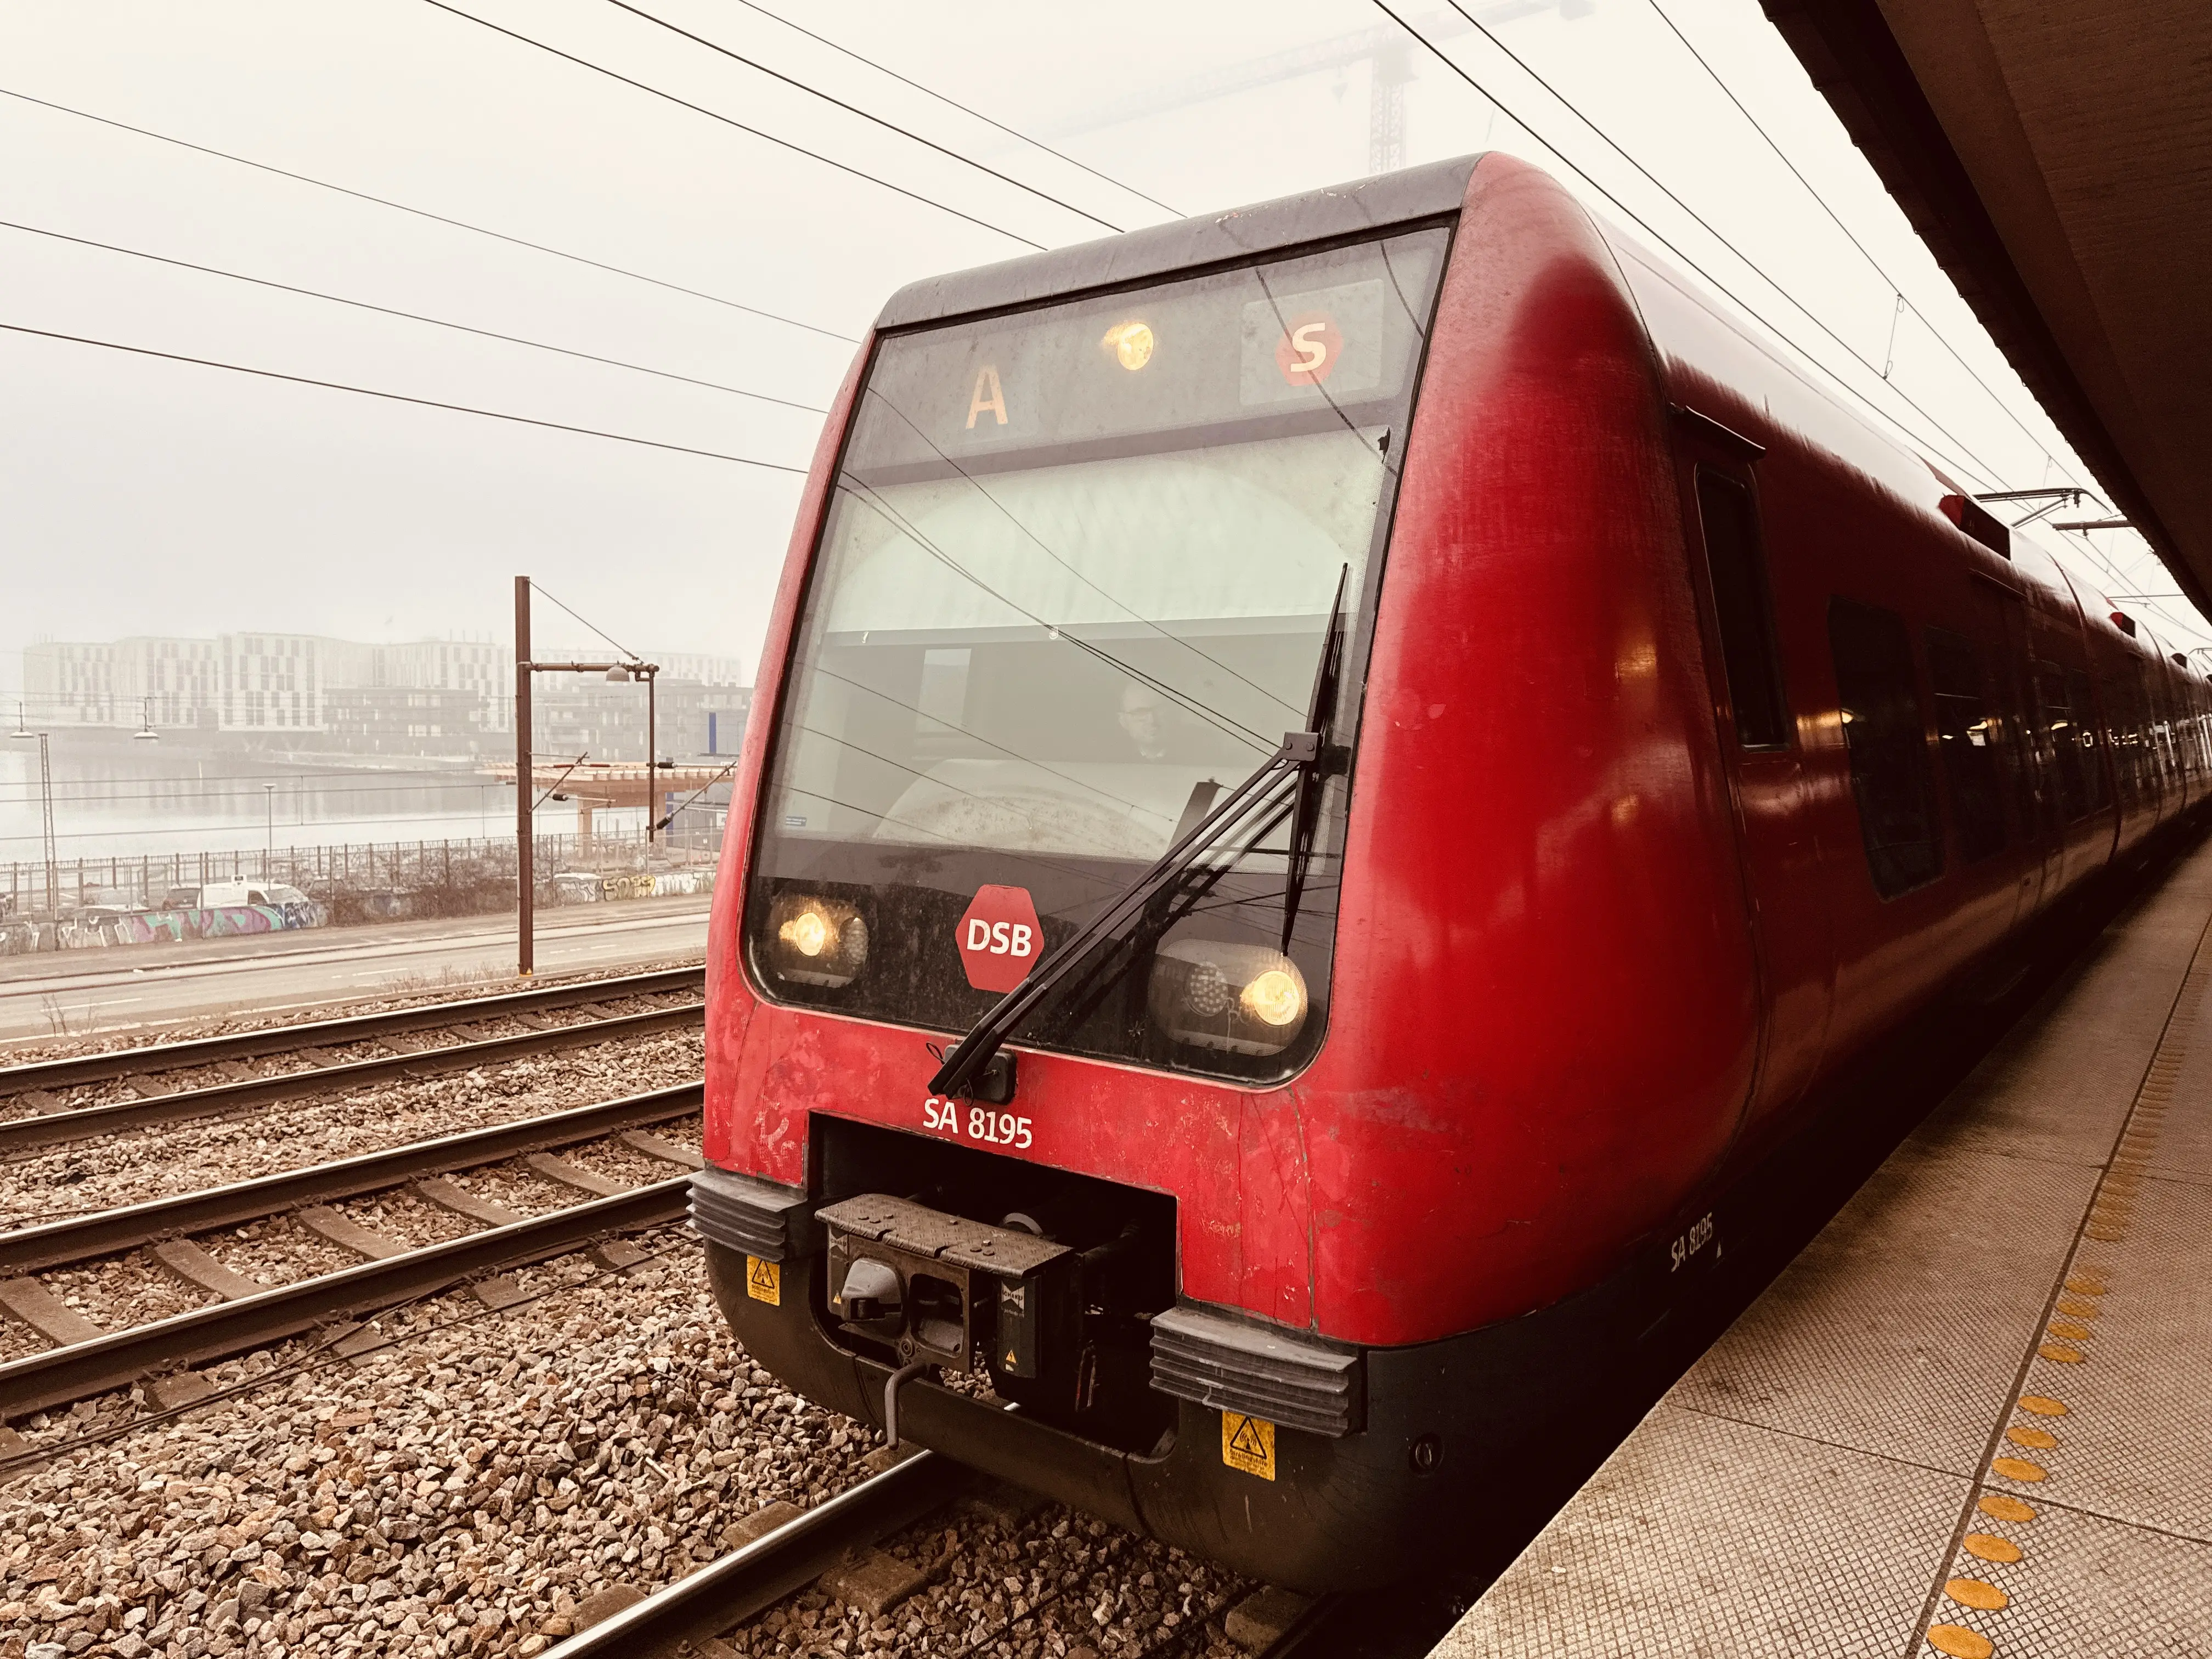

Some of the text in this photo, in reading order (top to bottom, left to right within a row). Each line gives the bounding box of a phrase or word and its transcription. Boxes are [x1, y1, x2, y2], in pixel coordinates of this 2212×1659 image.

[1290, 322, 1327, 372] S
[966, 364, 1008, 429] A
[967, 918, 1032, 957] DSB
[923, 1098, 1032, 1149] SA 8195
[1671, 1211, 1713, 1273] SA 8195
